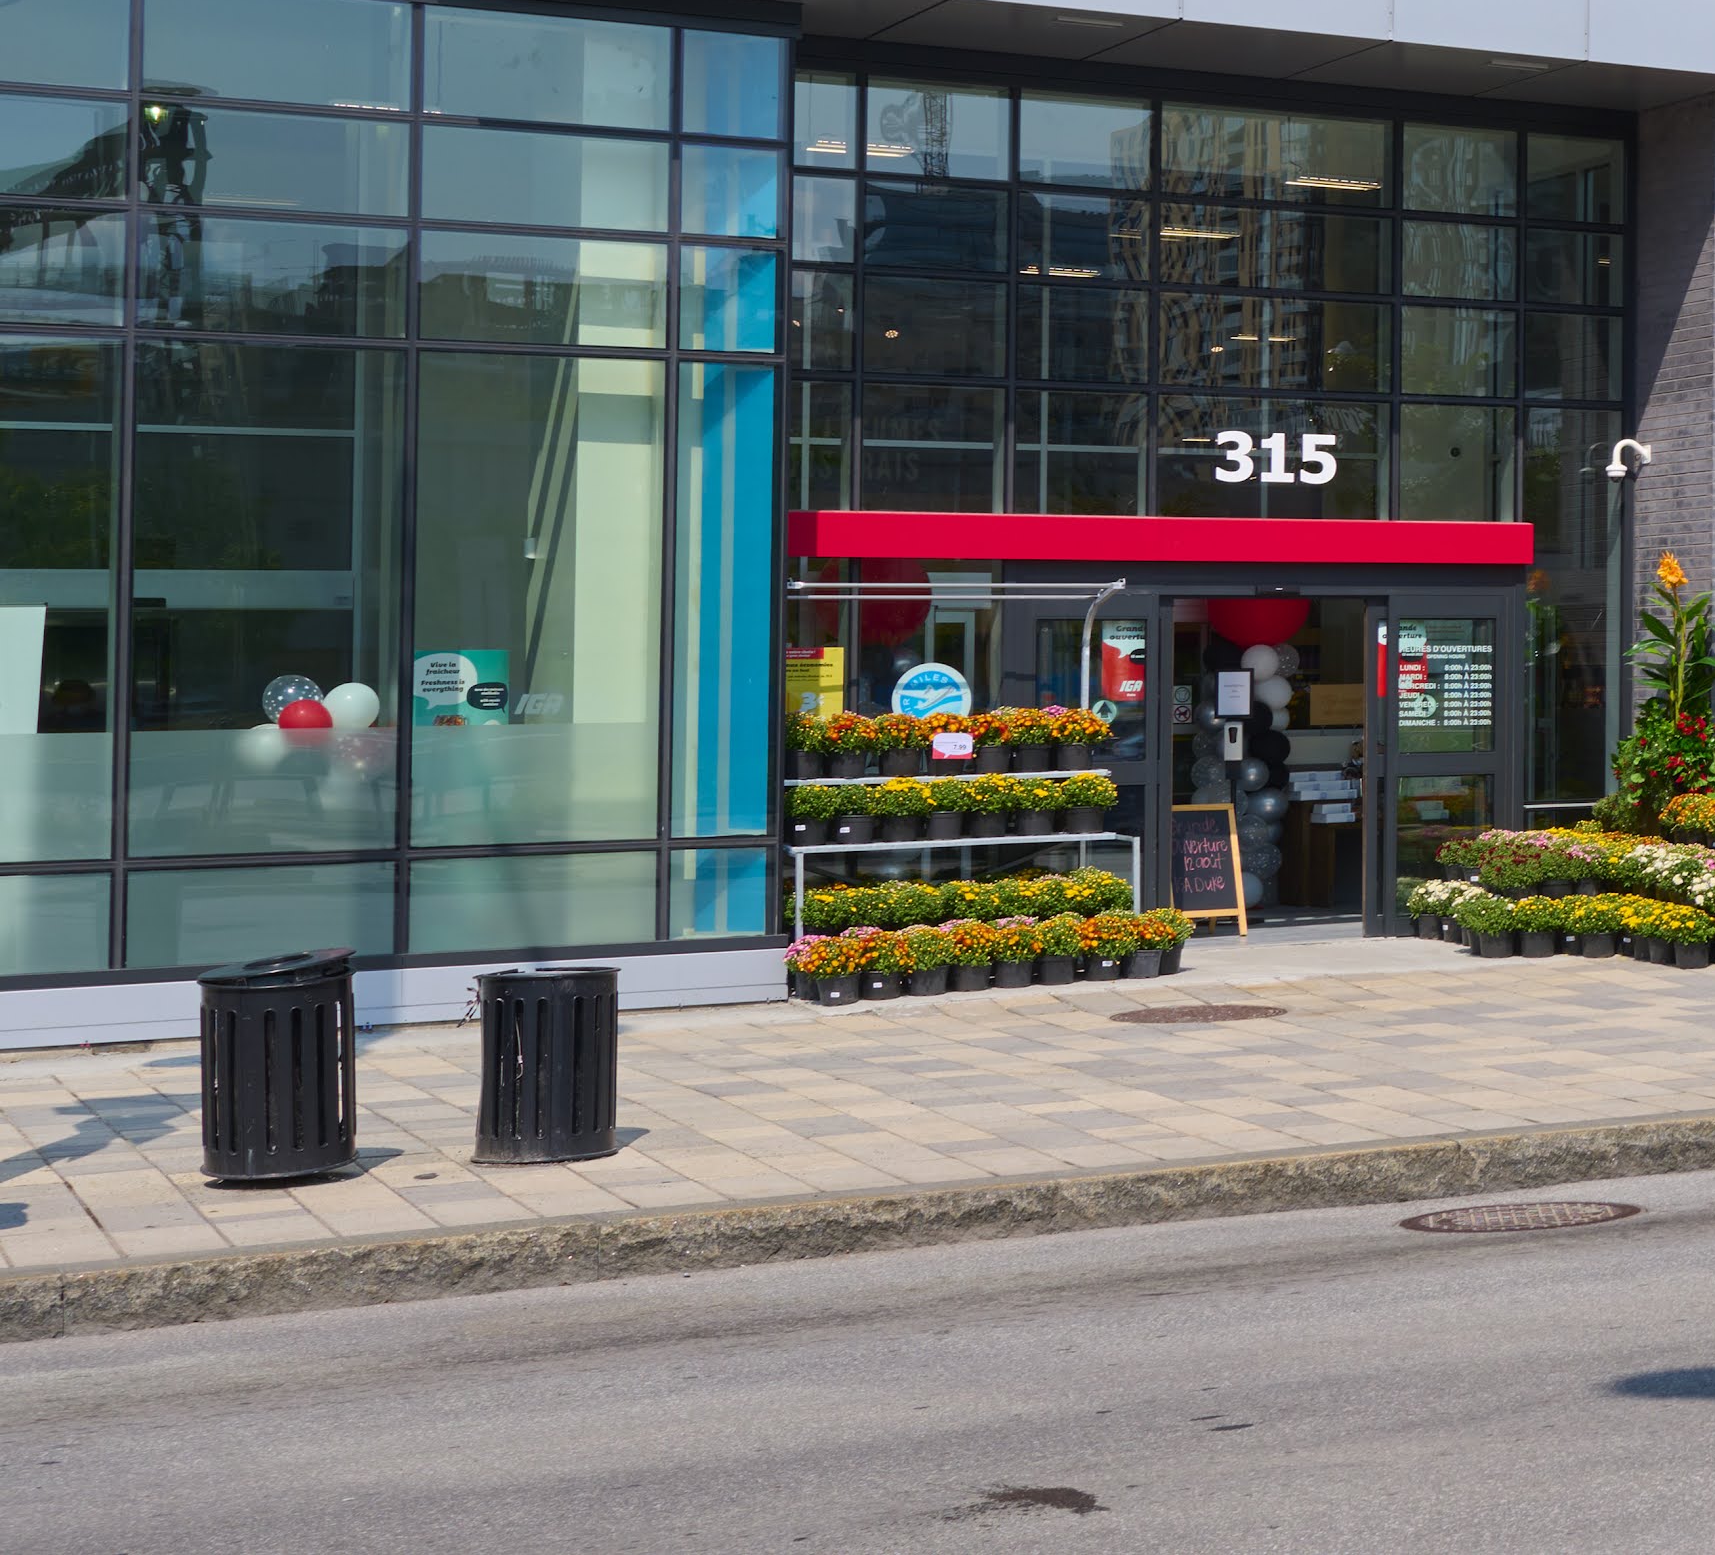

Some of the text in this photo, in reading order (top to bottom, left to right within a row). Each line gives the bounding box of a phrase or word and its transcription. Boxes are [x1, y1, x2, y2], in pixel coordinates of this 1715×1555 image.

[1215, 430, 1337, 485] 315
[1433, 645, 1493, 653] D'OUVERTURES
[1119, 680, 1144, 693] IGA
[514, 693, 564, 715] IGA
